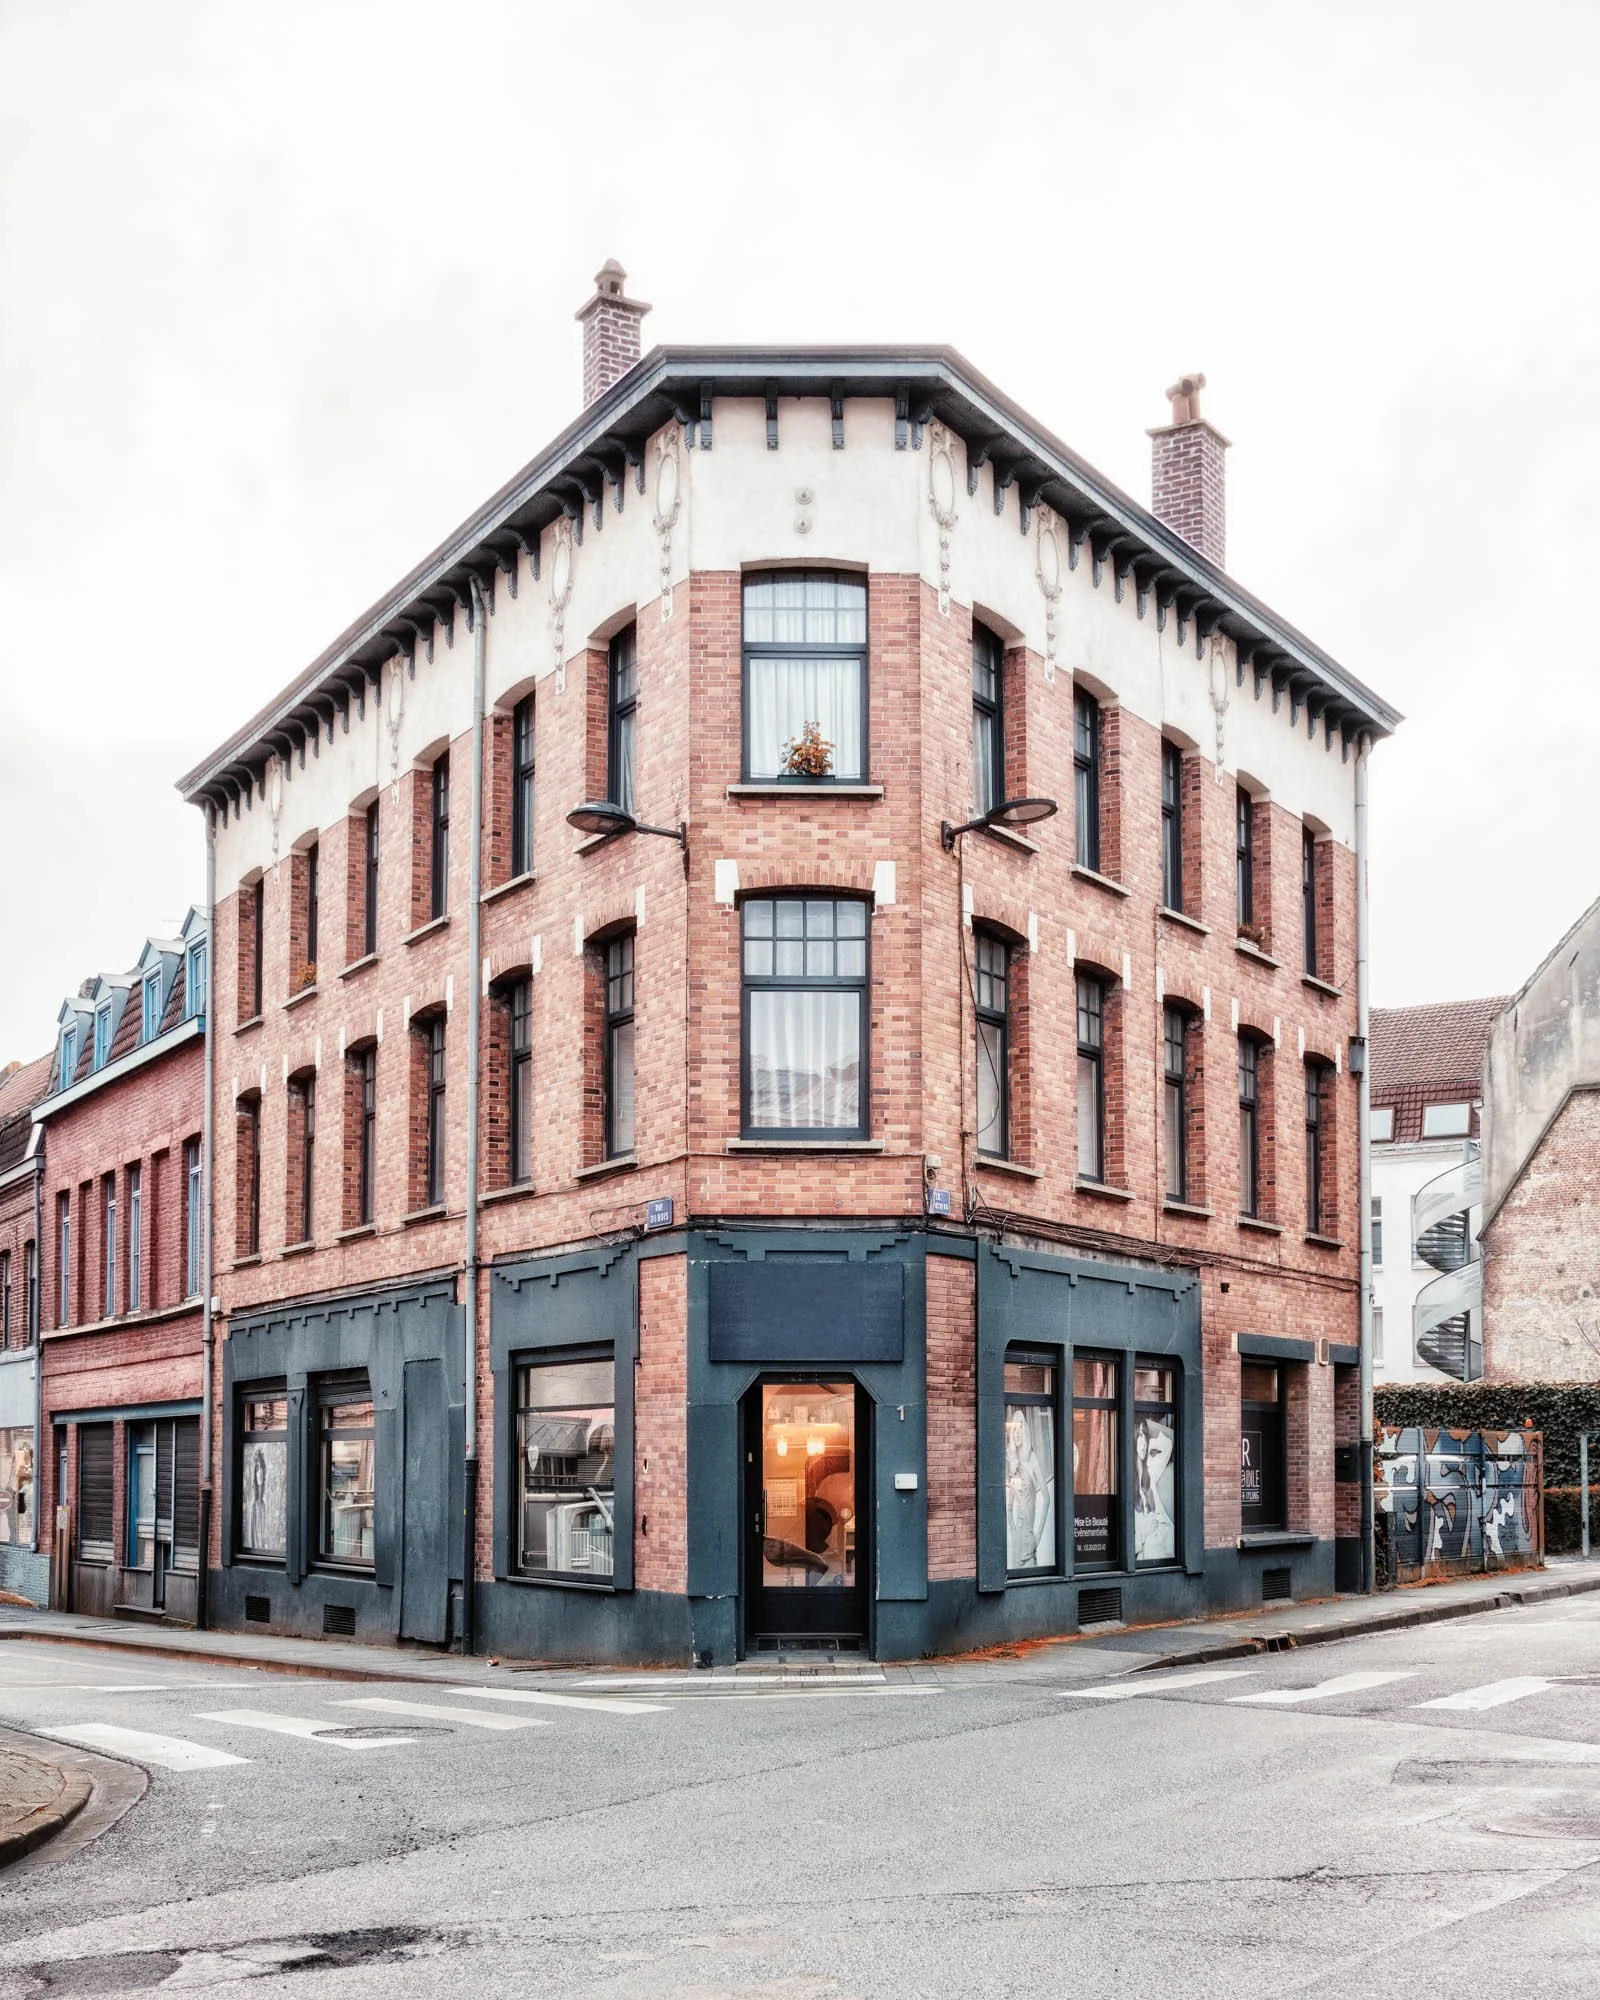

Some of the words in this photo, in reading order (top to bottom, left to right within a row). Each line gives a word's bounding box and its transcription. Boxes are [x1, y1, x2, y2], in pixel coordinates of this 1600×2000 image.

[657, 1212, 669, 1222] BOIS
[896, 1403, 905, 1421] 1
[1074, 1517, 1084, 1527] Mise
[1085, 1517, 1091, 1526] En
[1092, 1515, 1108, 1526] Beauté
